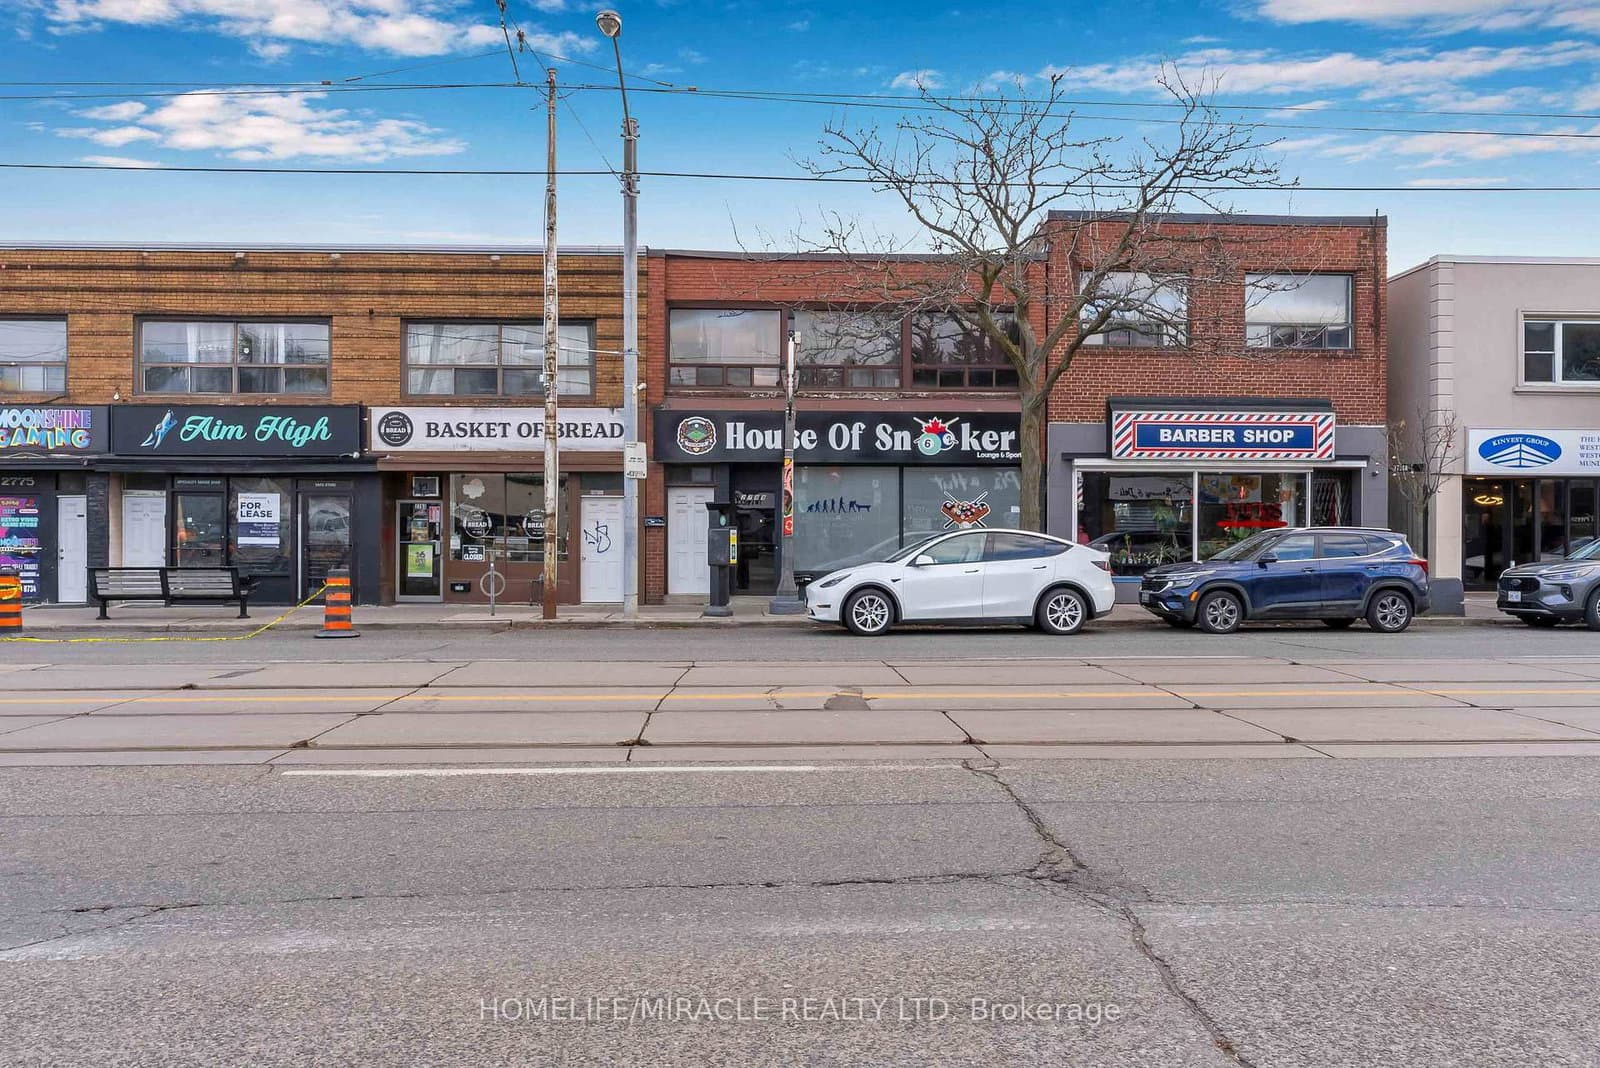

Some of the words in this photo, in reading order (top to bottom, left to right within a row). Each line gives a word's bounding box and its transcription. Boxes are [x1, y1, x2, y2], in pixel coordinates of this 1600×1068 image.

[180, 415, 247, 441] Aim
[255, 415, 332, 448] High
[425, 422, 511, 438] BASKET
[517, 422, 543, 438] OF
[557, 422, 625, 438] BREAD
[828, 423, 865, 451] Of
[1159, 429, 1235, 443] BARBER
[1243, 429, 1295, 443] SHOP
[1492, 436, 1523, 447] KINVEST
[1525, 437, 1550, 448] GROUP
[240, 502, 261, 510] FOR
[240, 510, 273, 518] LEASE
